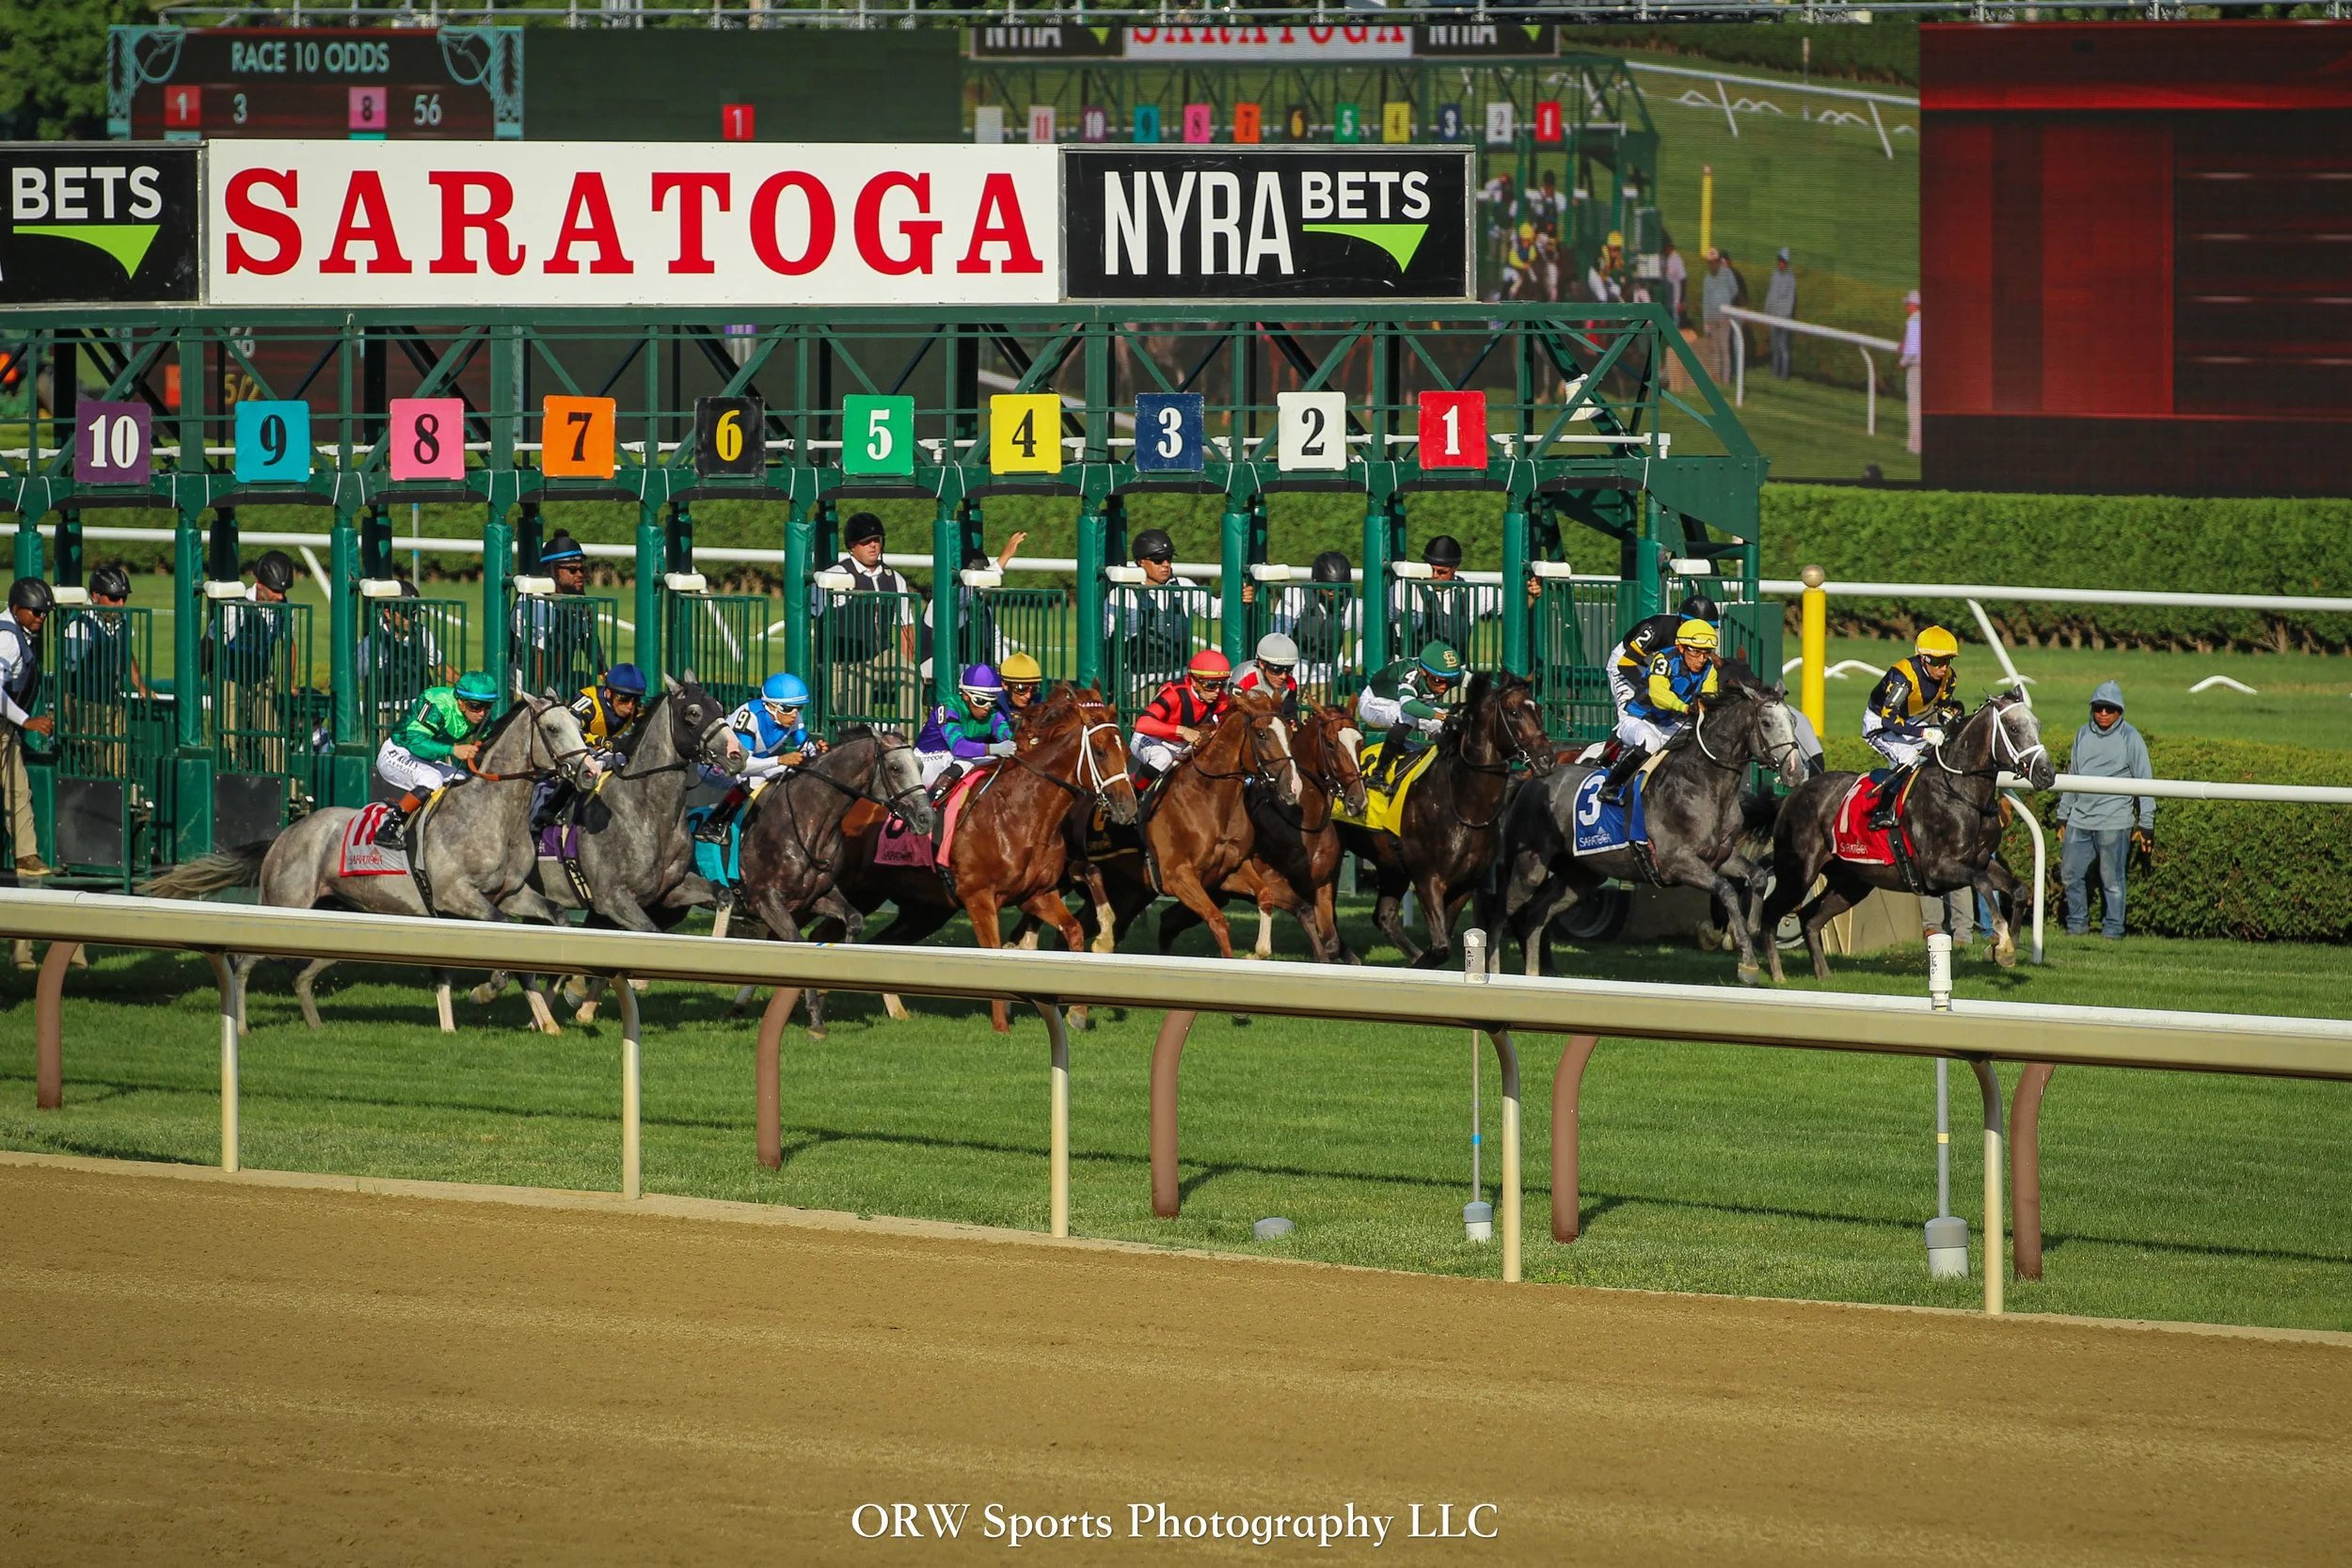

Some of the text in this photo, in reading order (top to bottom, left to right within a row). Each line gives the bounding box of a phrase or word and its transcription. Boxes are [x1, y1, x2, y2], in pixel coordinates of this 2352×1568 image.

[231, 41, 390, 73] RACE 10 ODDS
[176, 91, 187, 121] 1
[232, 93, 247, 125] 3
[360, 95, 373, 122] 8
[414, 93, 442, 126] 56
[732, 108, 744, 138] 1
[1342, 110, 1353, 136] 5
[1444, 109, 1457, 138] 3
[12, 166, 163, 219] BETS
[225, 167, 1043, 276] SARATOGA
[1104, 170, 1431, 275] NYRA BETS
[87, 414, 140, 469] 10
[260, 415, 287, 466] 9
[413, 414, 439, 465] 8
[566, 412, 593, 462] 7
[715, 410, 742, 461] 6
[866, 409, 894, 460] 5
[1011, 409, 1037, 458] 4
[1157, 407, 1184, 459] 3
[1300, 407, 1326, 456] 2
[1441, 405, 1461, 455] 1
[1634, 629, 1652, 648] 2
[1404, 670, 1419, 685] 4
[1654, 658, 1669, 675] 3
[571, 696, 593, 711] 10
[735, 710, 747, 730] 9
[937, 705, 946, 724] 8
[1579, 775, 1606, 826] 3
[1839, 784, 1863, 834] 1
[353, 802, 390, 846] 11
